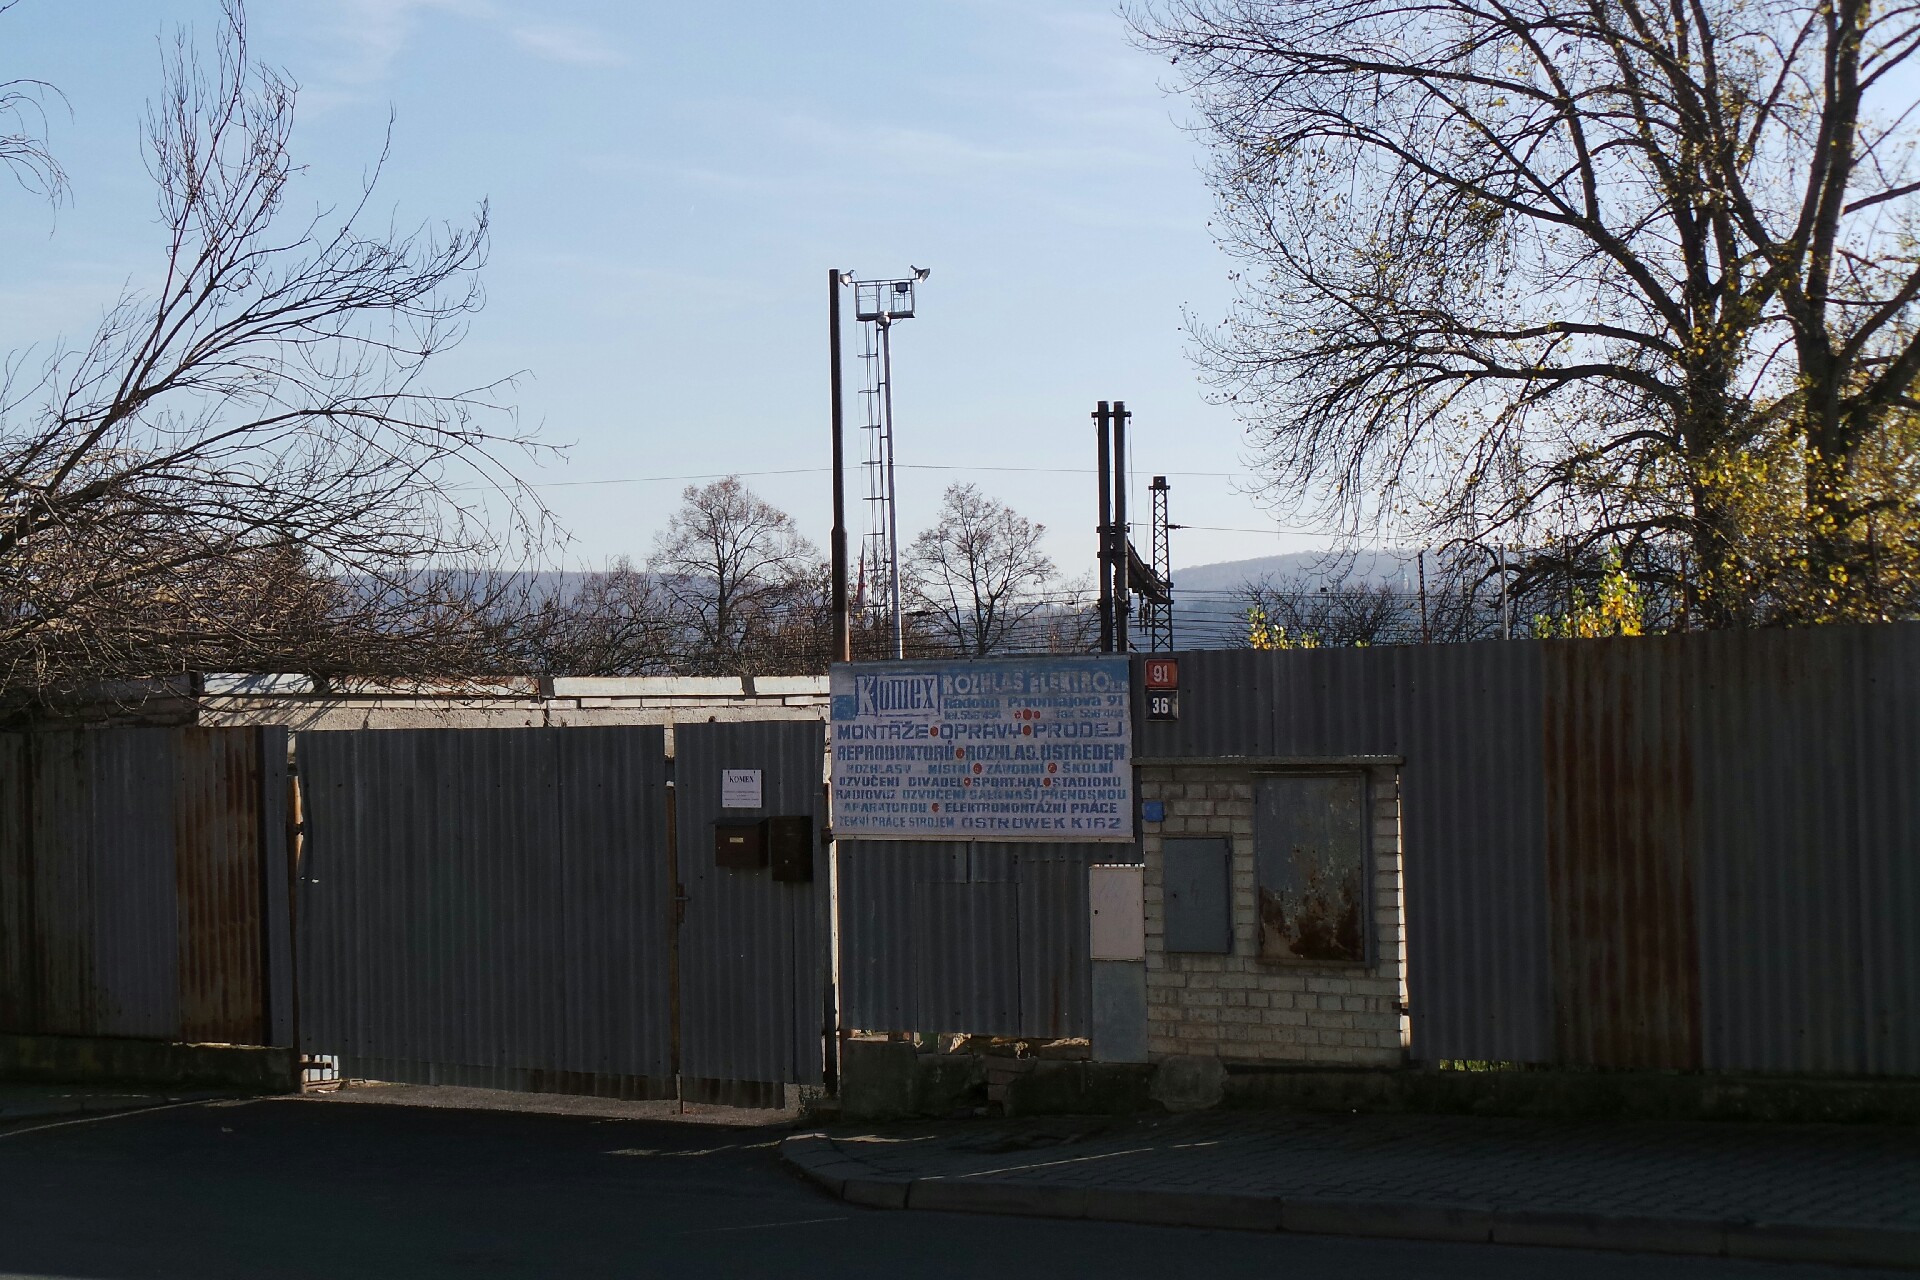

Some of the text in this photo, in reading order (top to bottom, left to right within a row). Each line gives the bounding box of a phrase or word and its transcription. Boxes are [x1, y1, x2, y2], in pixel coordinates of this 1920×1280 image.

[1153, 665, 1169, 683] 91
[942, 672, 1024, 695] ROZHLAS
[1030, 671, 1110, 693] ELEKTRO
[1107, 694, 1123, 706] 91
[1152, 697, 1169, 714] 36
[837, 720, 1122, 740] MONTÁŽE OPRAVY PRODEJ
[838, 739, 954, 761] REPRODUKTORŮ
[846, 760, 1113, 774] ROZHLASY MÍSTNÍ ZÁVODNÍ ŠKOLNÍ
[729, 775, 754, 783] KOMEX
[908, 777, 963, 787] DIVADEL
[844, 799, 1117, 813] APARATUROU ELEKTROMONTÁŽNÍ PRÁCE
[872, 815, 905, 827] PRÁCE
[909, 816, 954, 828] STROJEM
